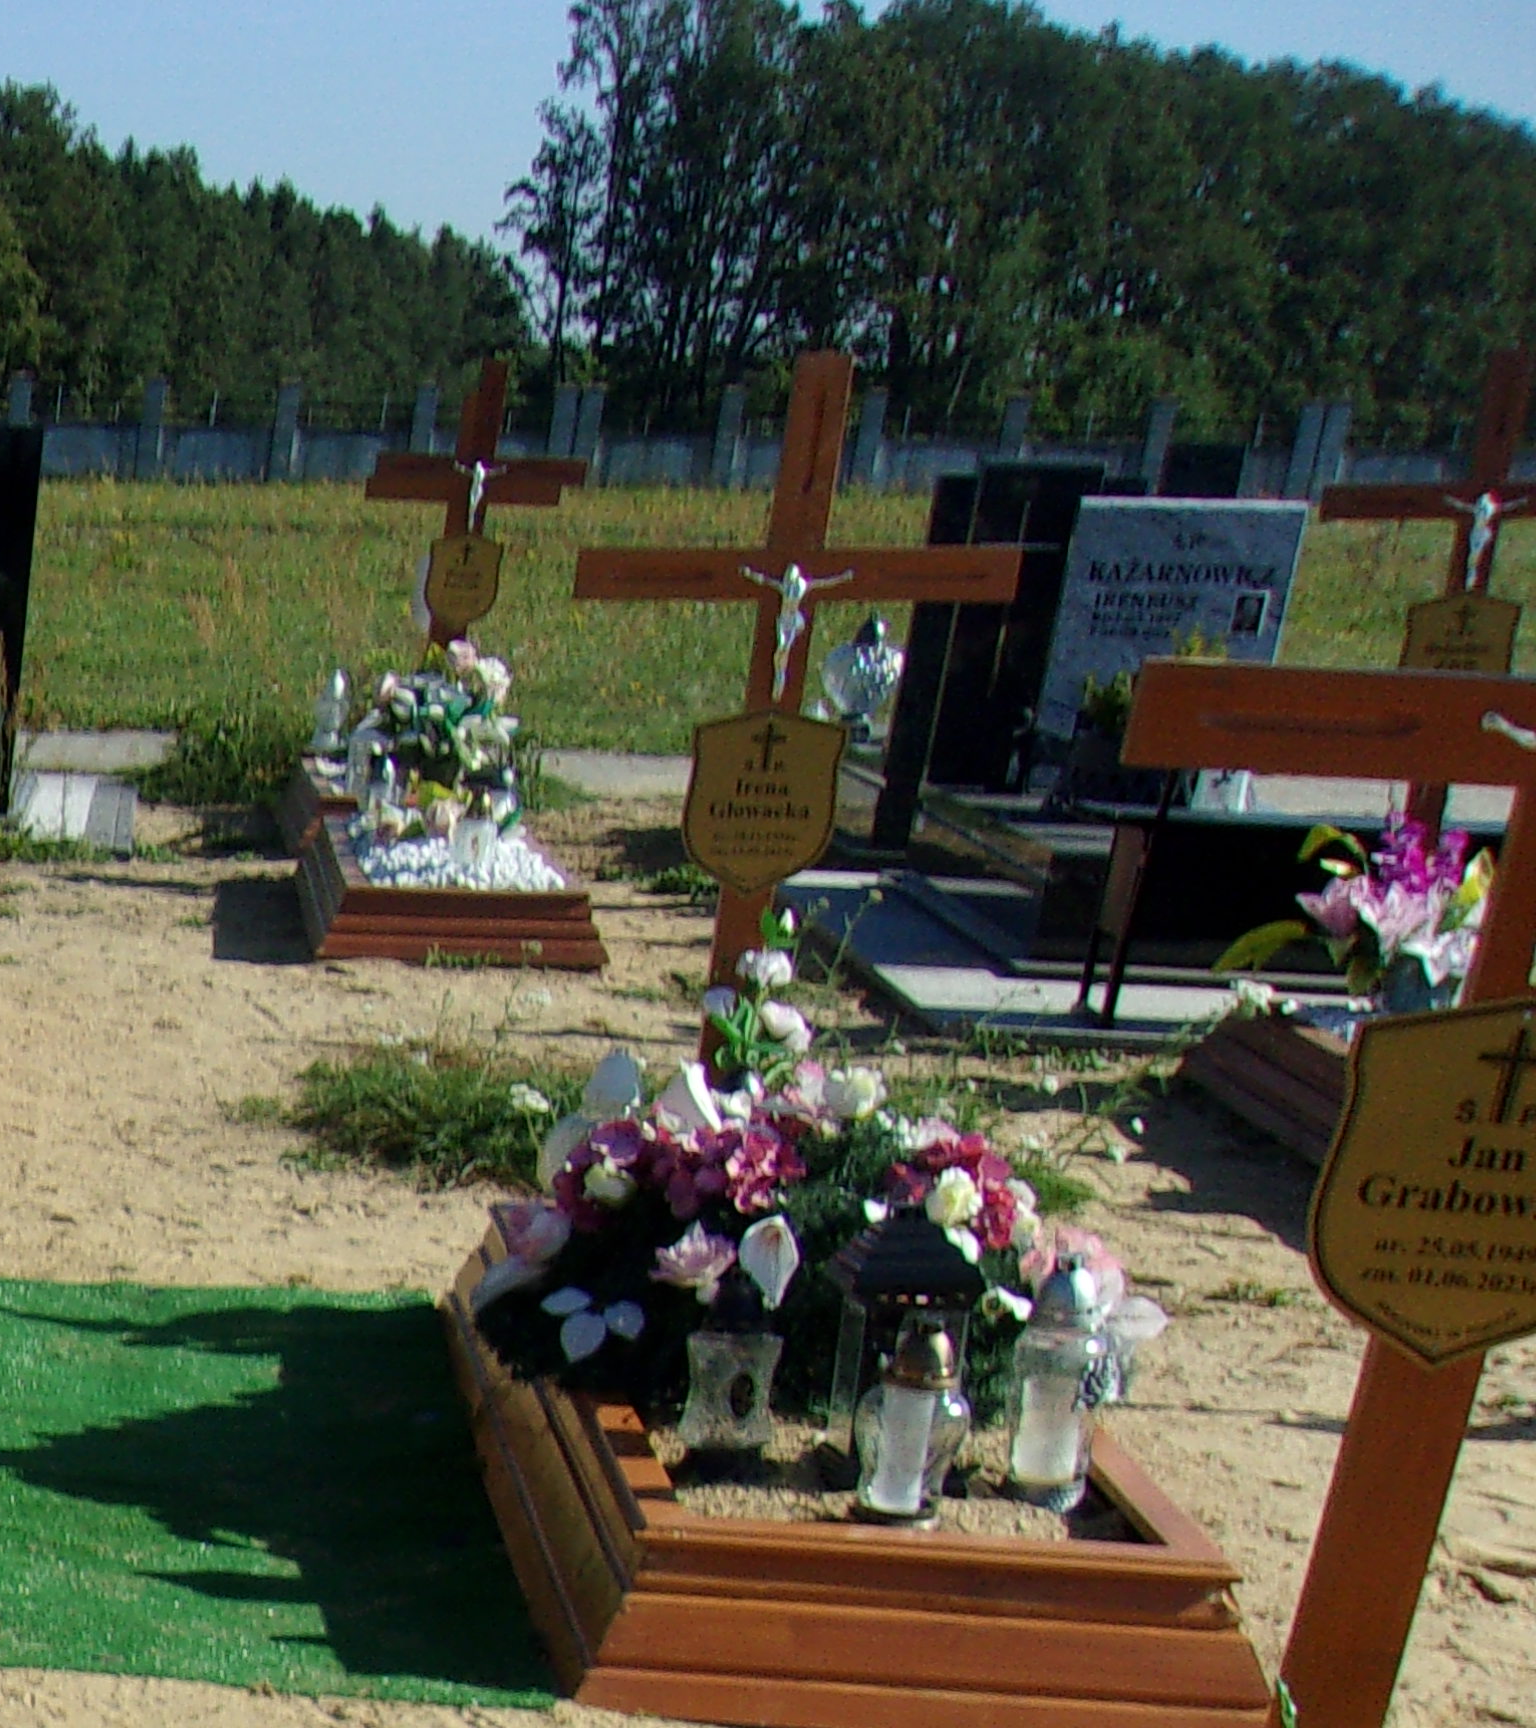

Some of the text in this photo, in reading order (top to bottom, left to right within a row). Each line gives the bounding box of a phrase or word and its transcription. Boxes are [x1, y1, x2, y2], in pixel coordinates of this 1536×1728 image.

[735, 777, 790, 798] Irena
[1447, 1135, 1525, 1172] Jan
[1356, 1171, 1536, 1220] Grabow
